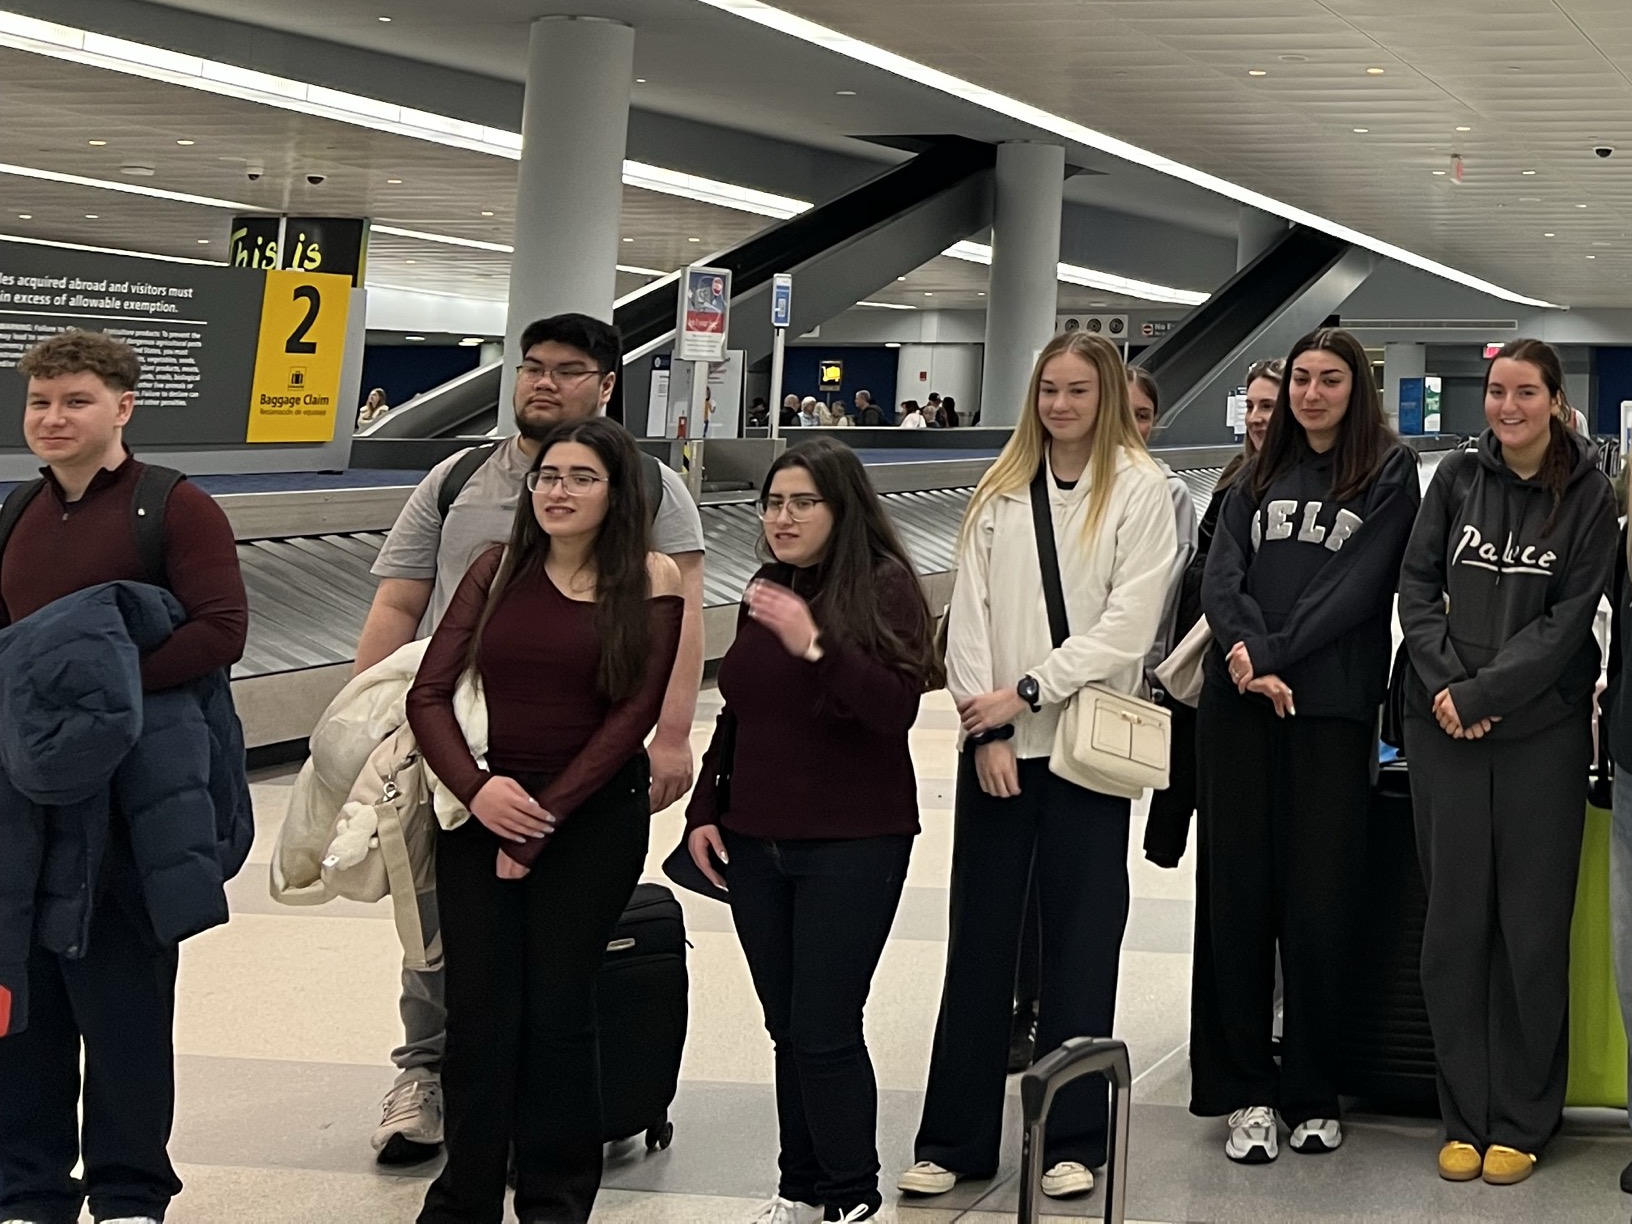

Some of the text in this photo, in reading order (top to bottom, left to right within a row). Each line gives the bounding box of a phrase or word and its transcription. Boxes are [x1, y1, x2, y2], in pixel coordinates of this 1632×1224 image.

[292, 233, 322, 270] is
[17, 276, 67, 290] acquired
[68, 278, 107, 292] abroad
[108, 282, 128, 293] and
[130, 282, 167, 296] visitors
[168, 288, 193, 298] must
[13, 293, 51, 305] excess
[53, 293, 68, 306] of
[68, 295, 121, 309] allowable
[123, 300, 179, 314] exemption.
[285, 285, 321, 354] 2
[260, 394, 329, 408] Baggage Claim
